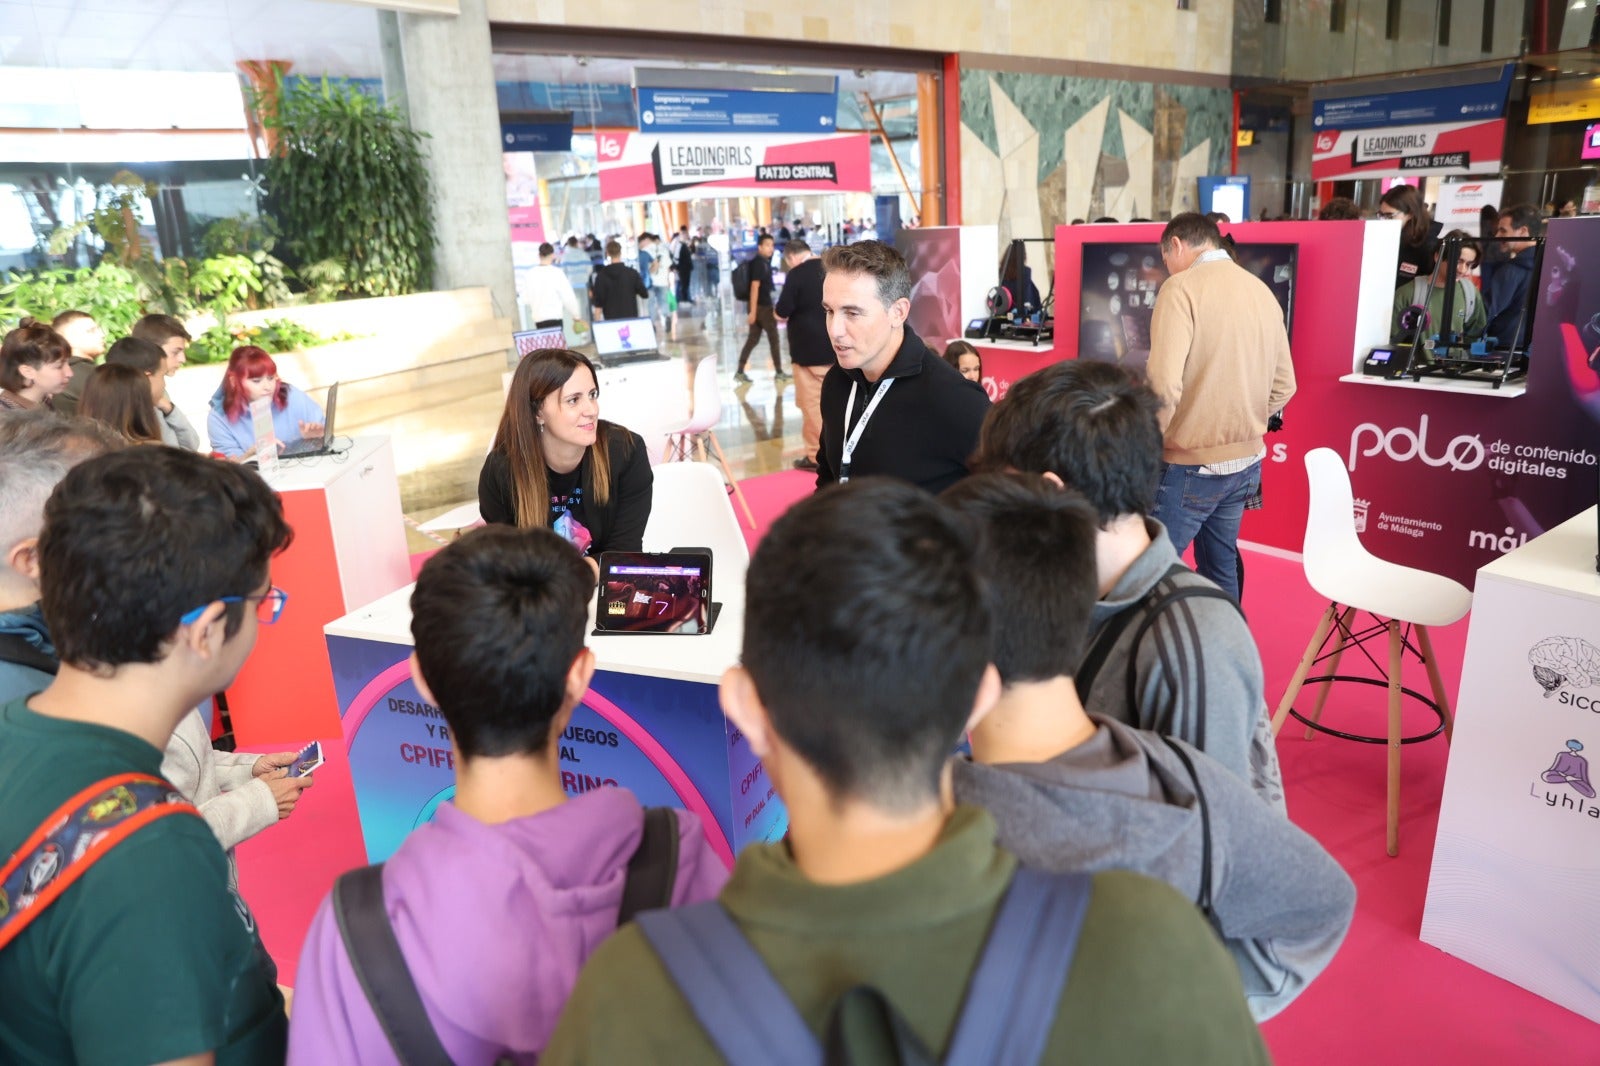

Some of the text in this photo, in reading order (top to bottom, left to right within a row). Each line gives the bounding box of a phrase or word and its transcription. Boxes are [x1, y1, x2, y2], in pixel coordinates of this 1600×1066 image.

[1363, 133, 1426, 151] LEADINGIRLS
[669, 145, 752, 167] LEADINGIRLS
[1404, 155, 1463, 168] MAIN STAGE
[759, 165, 834, 179] PATIO CENTRAL
[1490, 439, 1599, 466] de contenido
[1488, 456, 1567, 479] digitales
[1377, 521, 1424, 538] de Málaga
[1378, 511, 1442, 531] Ayuntamiento
[425, 723, 436, 739] Y
